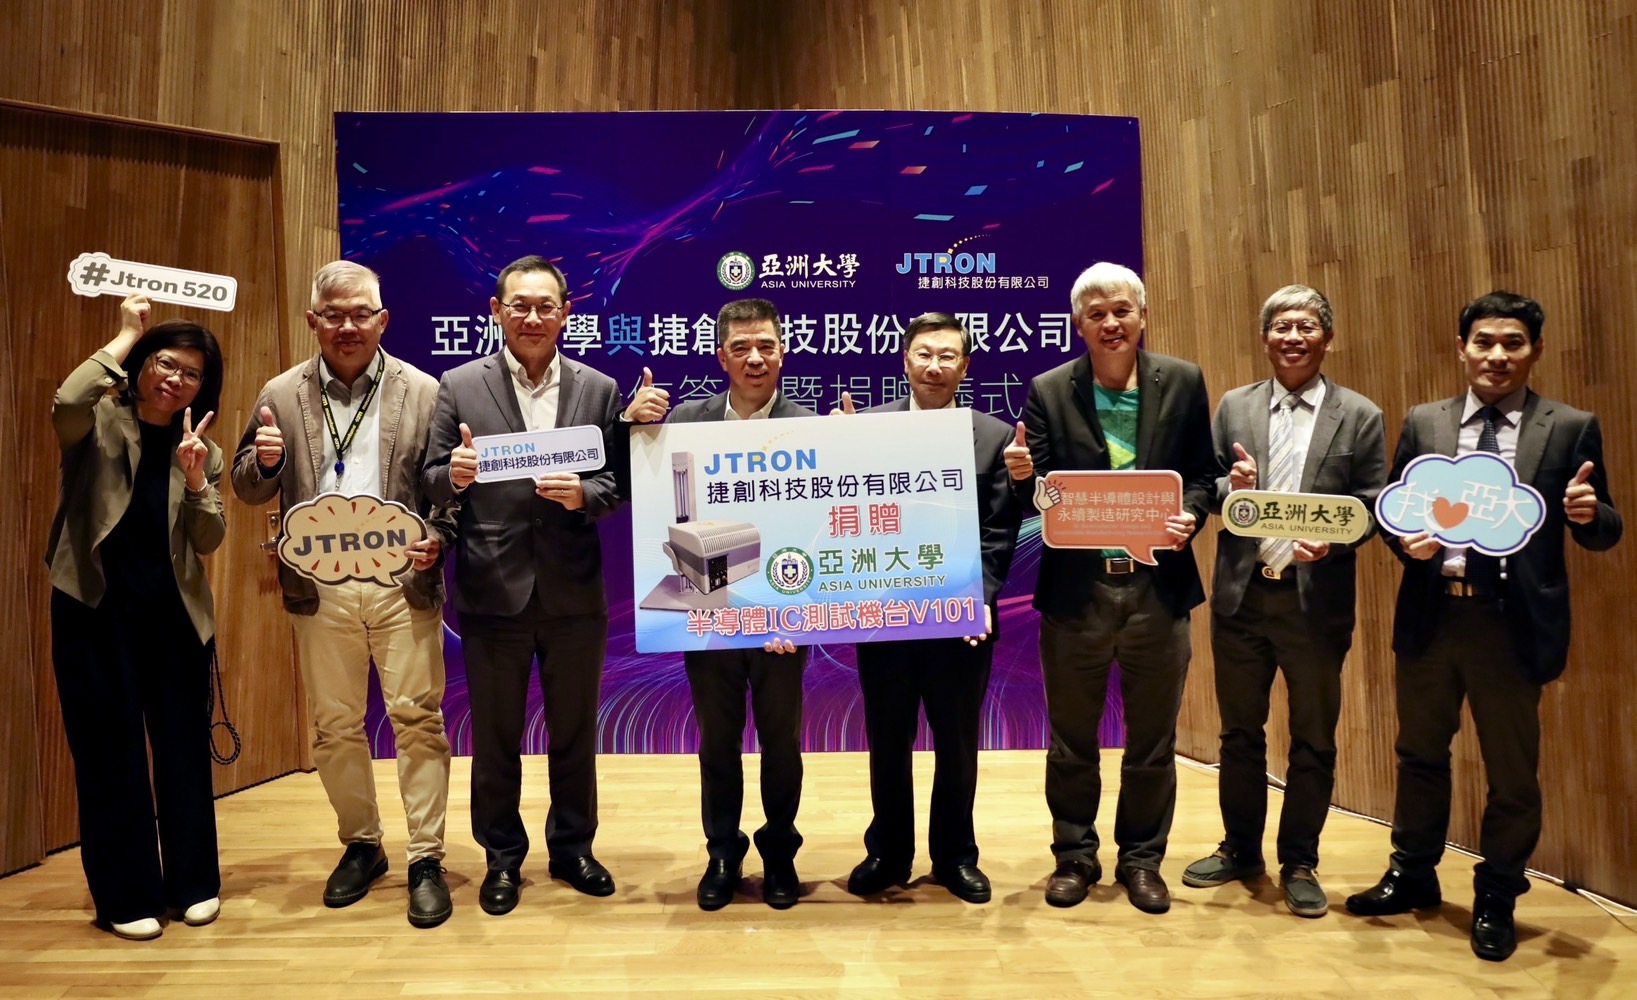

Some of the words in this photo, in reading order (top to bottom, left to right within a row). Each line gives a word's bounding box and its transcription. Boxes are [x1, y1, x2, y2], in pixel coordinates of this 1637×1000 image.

[758, 252, 861, 280] 亞洲大學
[896, 252, 996, 275] JTRON
[79, 261, 179, 295] #Jtron
[182, 280, 228, 302] 520
[761, 280, 786, 289] ASIA
[791, 280, 857, 289] UNIVERSITY
[917, 275, 1049, 289] 捷創科技股份有限公司
[478, 448, 599, 473] 捷創科技股份有限公司
[480, 442, 536, 459] JTRON
[704, 448, 818, 475] JTRON
[707, 468, 964, 504] 捷創科技股份有限公司
[1061, 491, 1175, 506] 智慧半導體設計與
[828, 501, 902, 538] 捐贈
[1260, 501, 1355, 527] 亞洲大學
[1261, 523, 1285, 531] ASIA
[1290, 524, 1353, 535] UNIVERSITY
[293, 529, 407, 557] JTRON
[818, 543, 945, 576] 亞洲大學
[818, 579, 853, 592] ASIA
[858, 574, 946, 590] UNIVERSITY
[686, 596, 976, 637] 半導體IC測試機台V101
